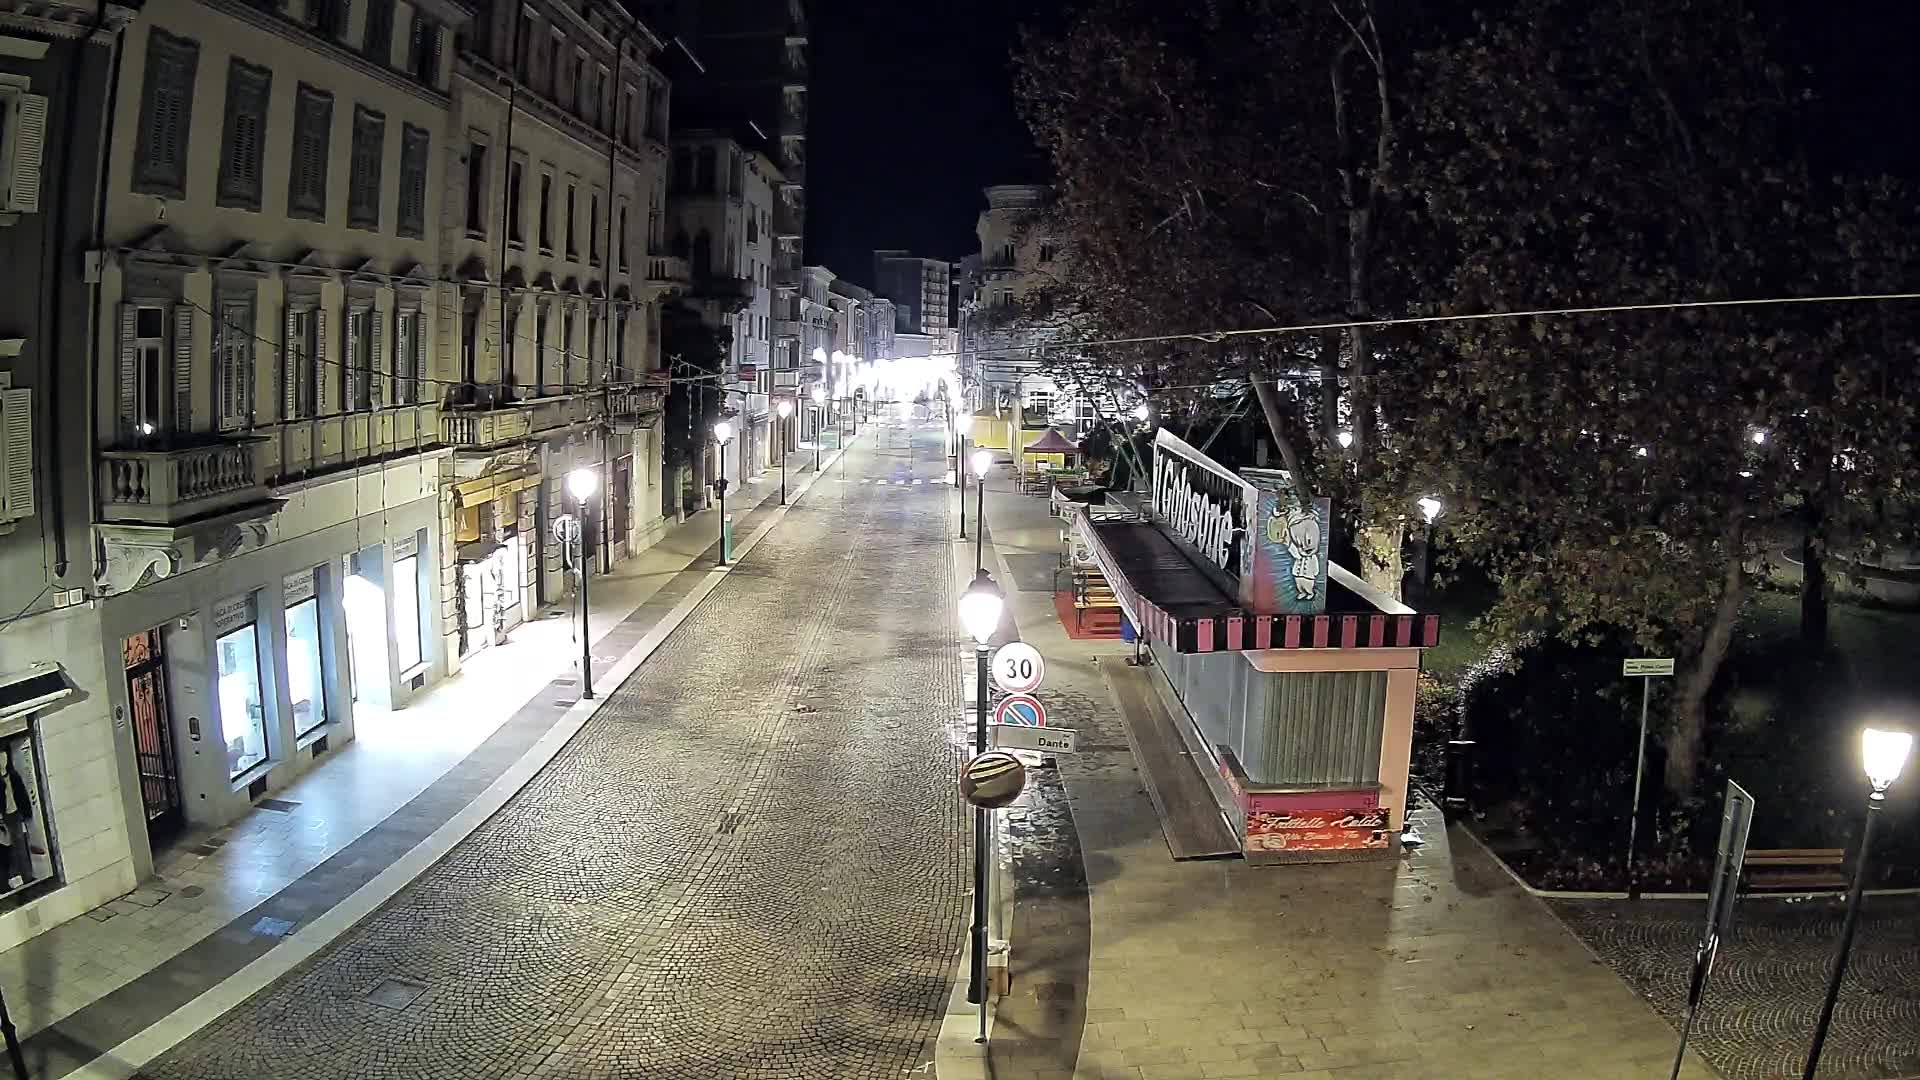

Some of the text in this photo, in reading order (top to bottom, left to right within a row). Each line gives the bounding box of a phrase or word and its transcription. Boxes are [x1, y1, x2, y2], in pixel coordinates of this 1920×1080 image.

[1162, 458, 1233, 570] Golosone
[1006, 658, 1032, 679] 30
[1038, 737, 1069, 748] Dante
